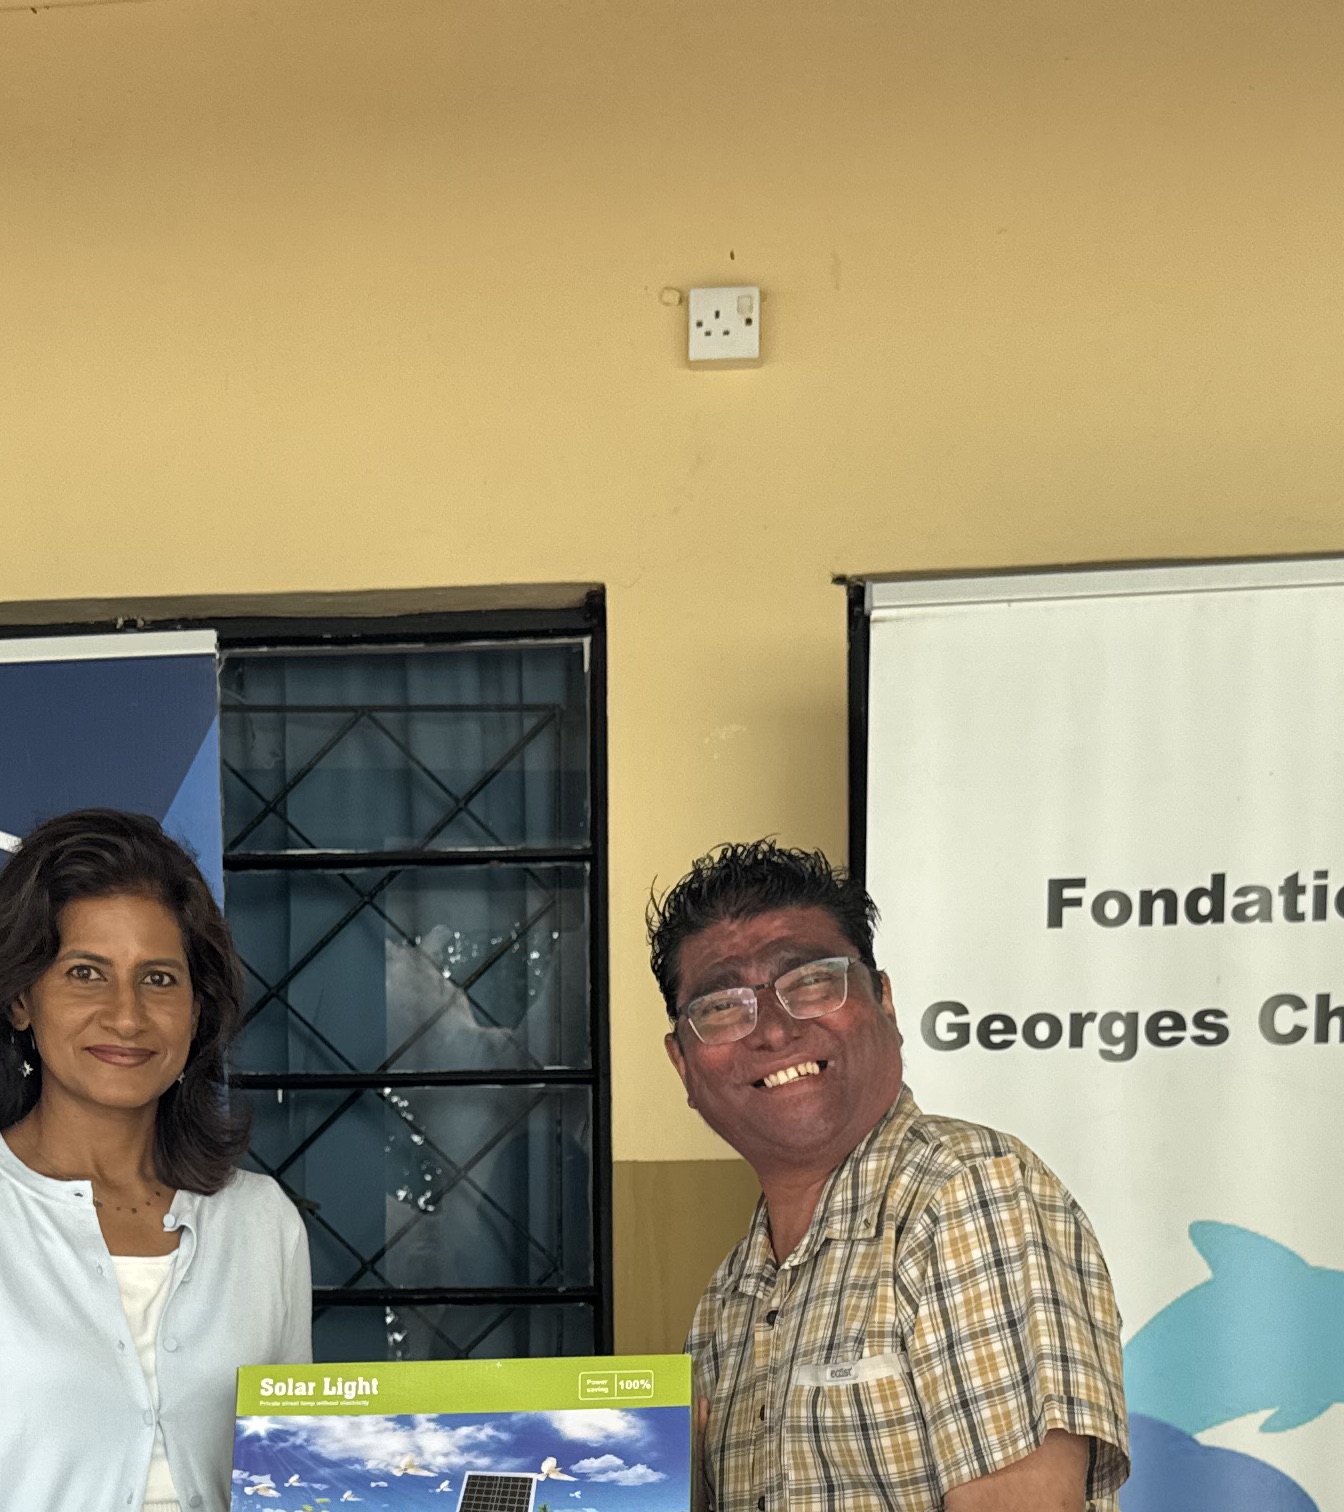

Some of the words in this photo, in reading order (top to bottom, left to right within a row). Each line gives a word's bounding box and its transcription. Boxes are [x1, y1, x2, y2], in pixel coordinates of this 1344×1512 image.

[919, 1000, 1230, 1063] Georges
[260, 1377, 316, 1397] Solar
[323, 1376, 379, 1400] Light
[618, 1379, 652, 1390] 100%
